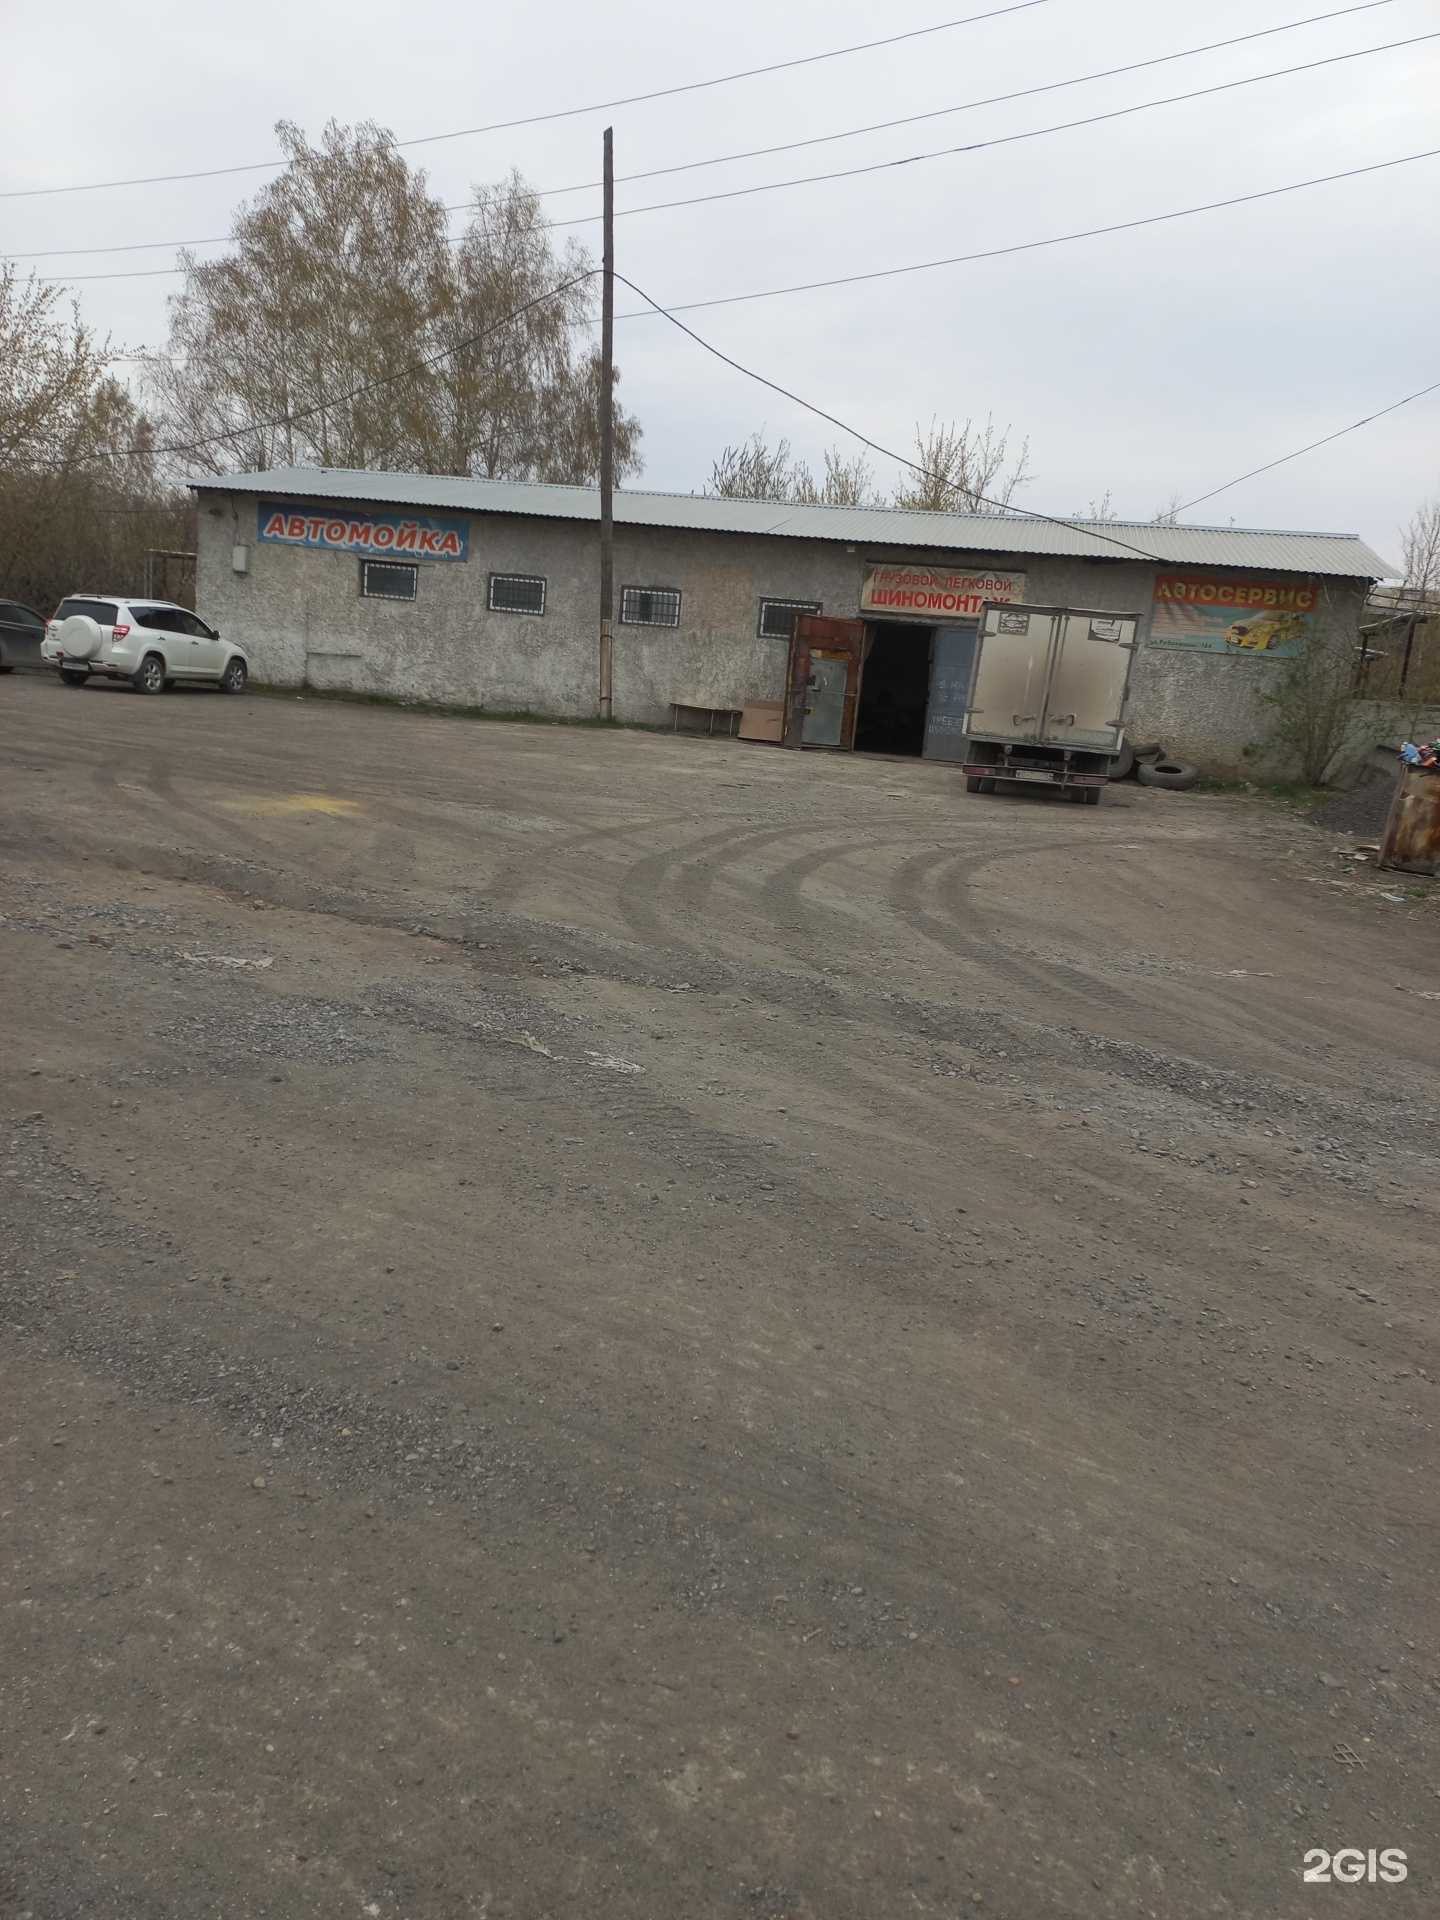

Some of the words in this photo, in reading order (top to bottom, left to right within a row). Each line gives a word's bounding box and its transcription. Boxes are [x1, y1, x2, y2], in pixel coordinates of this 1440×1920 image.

[264, 513, 461, 555] АВТОМОЙКА
[871, 590, 1010, 613] ШИНОМОНТ
[1158, 582, 1312, 608] АВТОСЕРВИС
